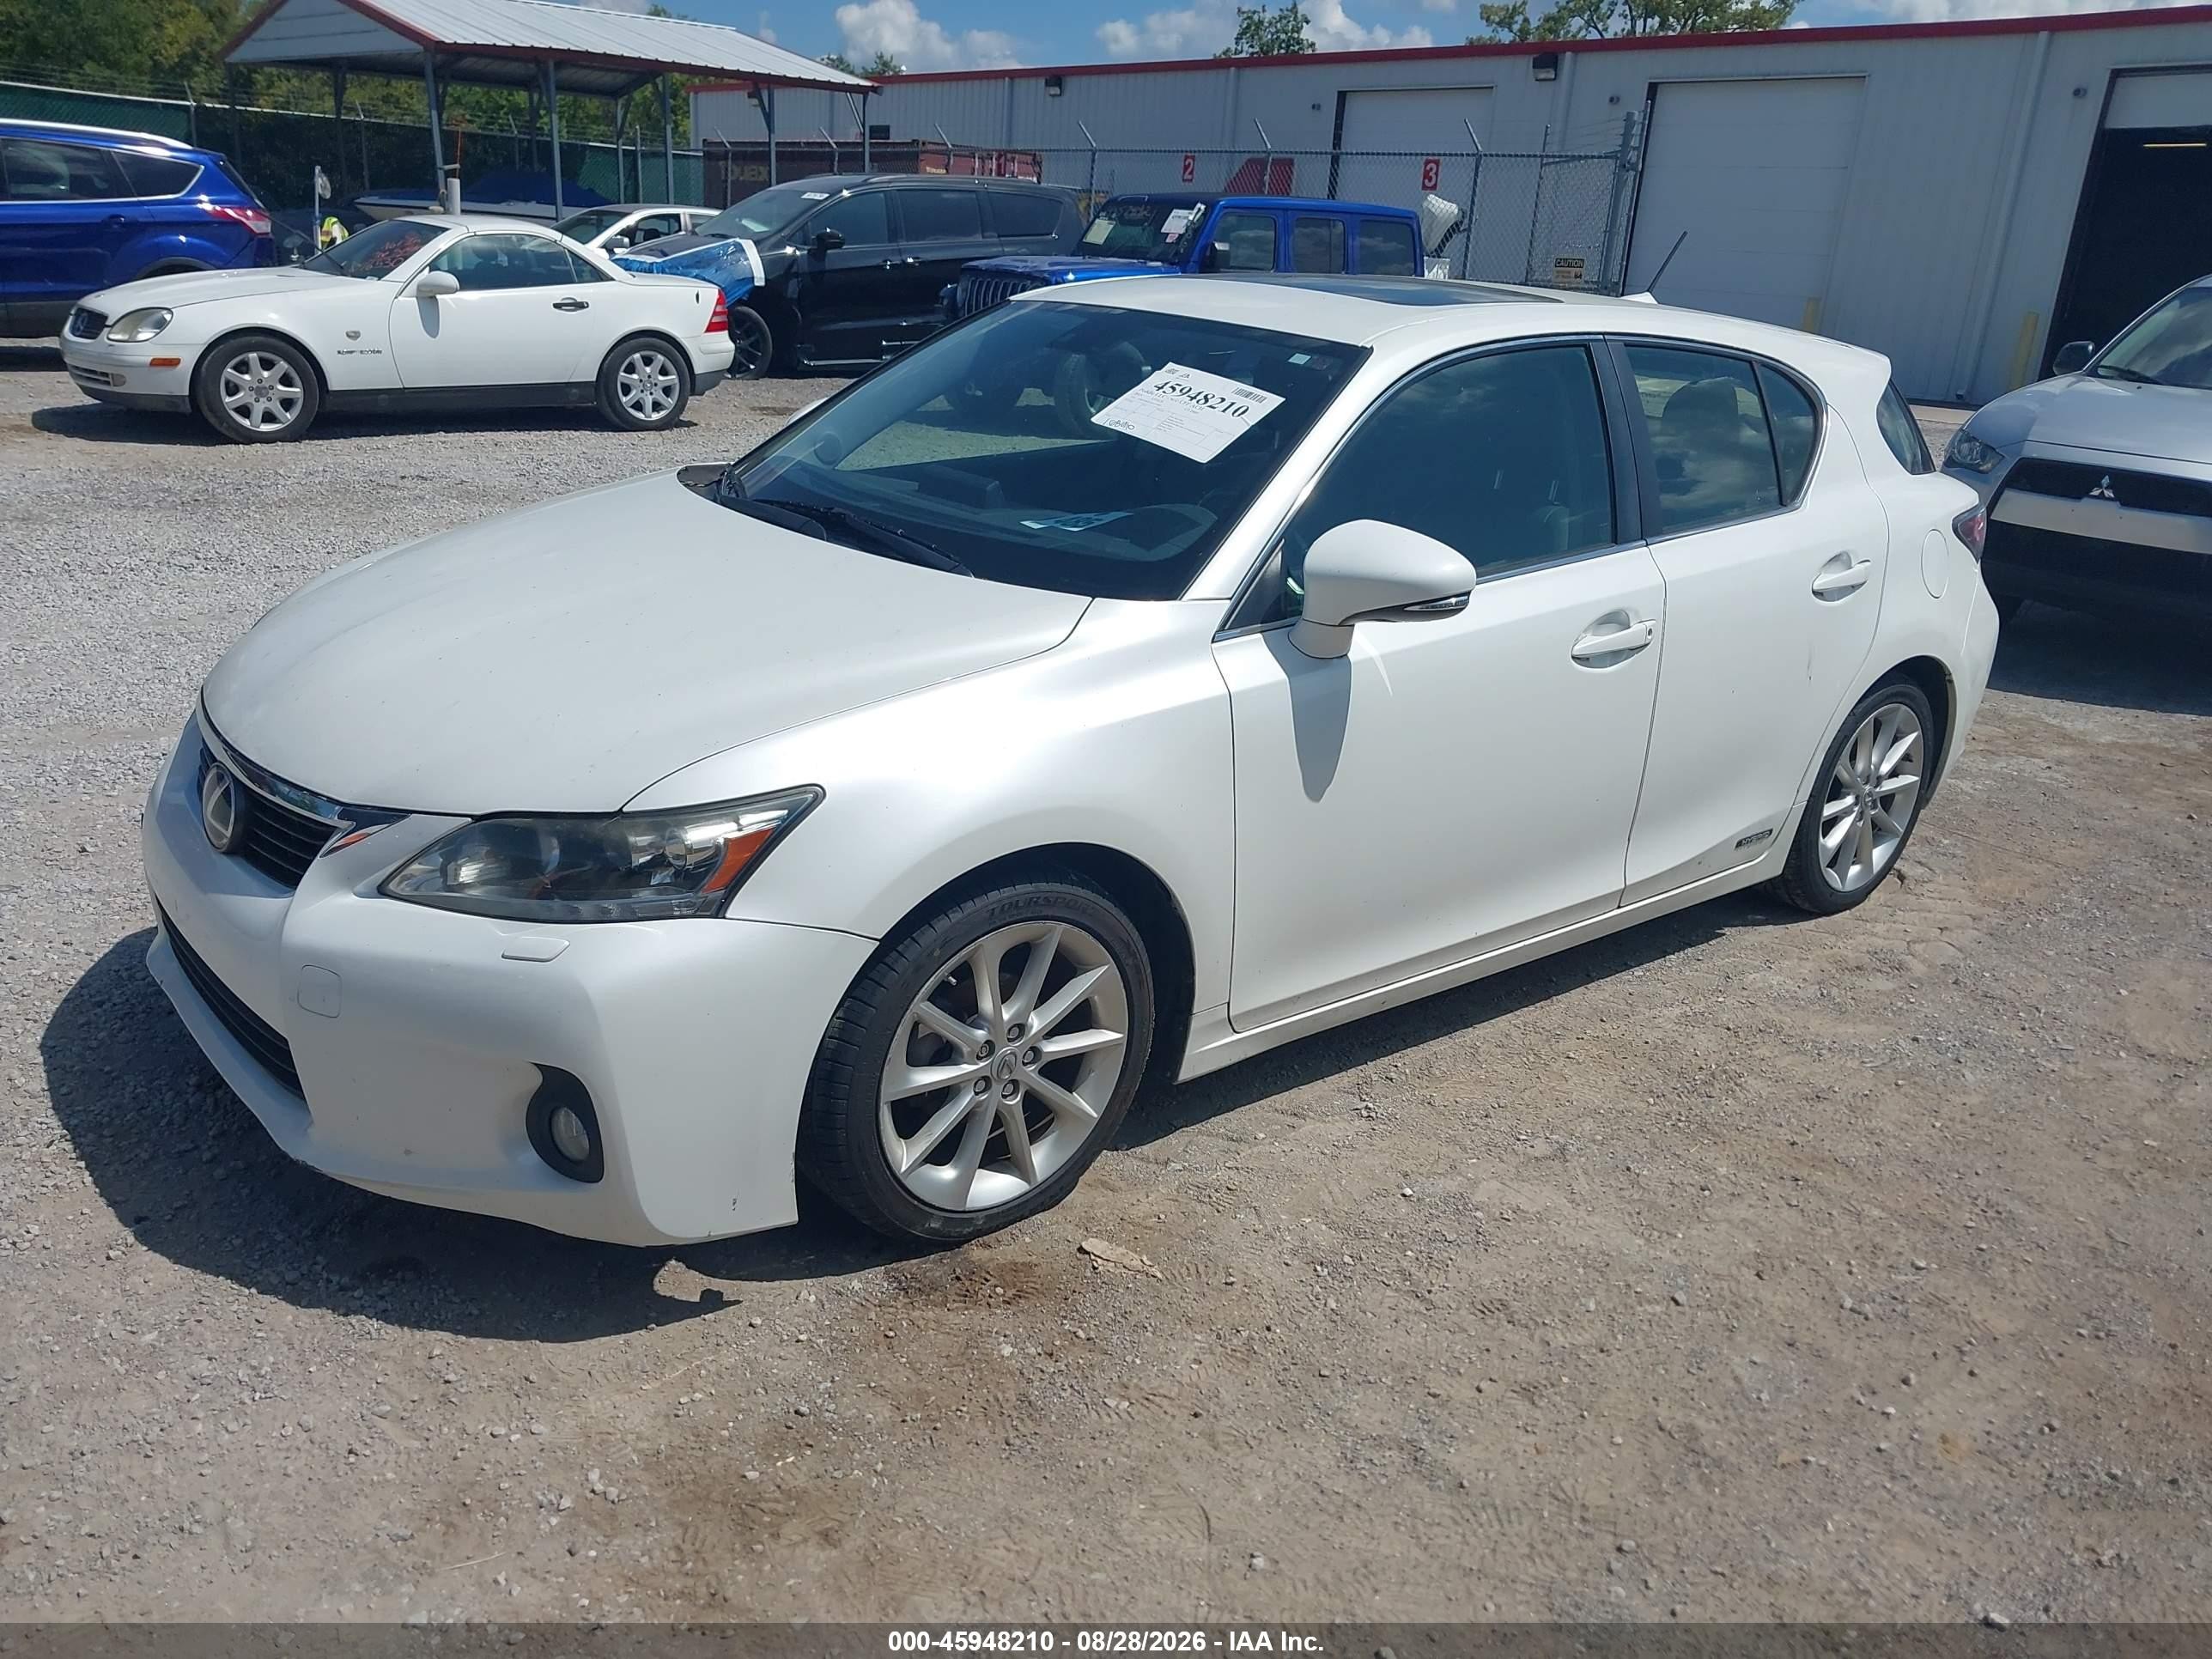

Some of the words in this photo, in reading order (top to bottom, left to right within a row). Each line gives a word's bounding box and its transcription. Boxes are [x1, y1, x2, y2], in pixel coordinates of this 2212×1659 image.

[1184, 158, 1194, 179] 2
[1424, 162, 1437, 187] 3
[1555, 258, 1583, 267] CAUTION
[1153, 380, 1249, 417] 45948210
